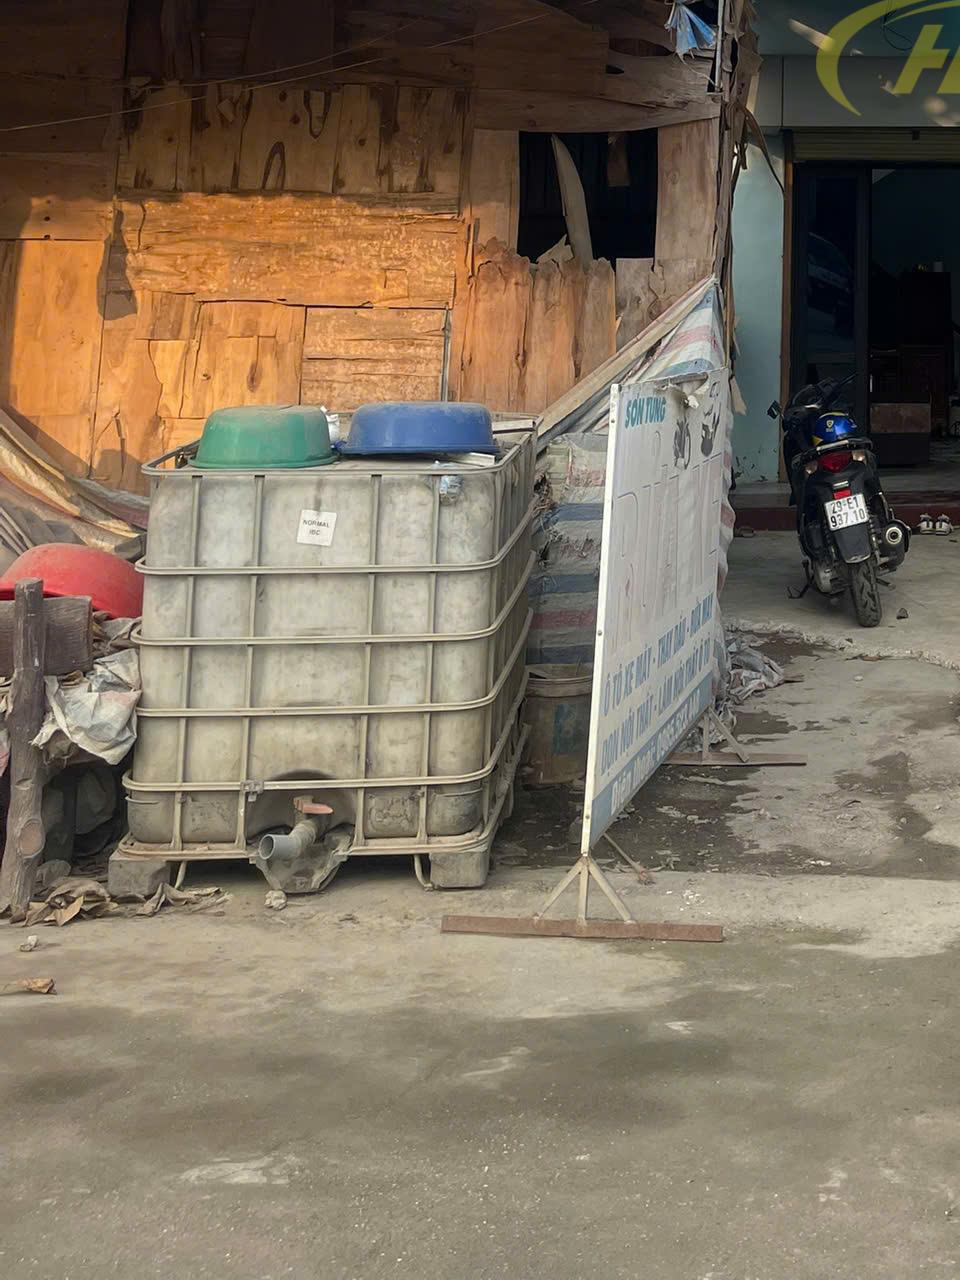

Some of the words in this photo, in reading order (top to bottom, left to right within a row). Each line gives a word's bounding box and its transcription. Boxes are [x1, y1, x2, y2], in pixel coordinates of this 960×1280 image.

[831, 496, 860, 514] 29-E1
[303, 519, 330, 528] NORMAL
[830, 508, 866, 528] 937.10
